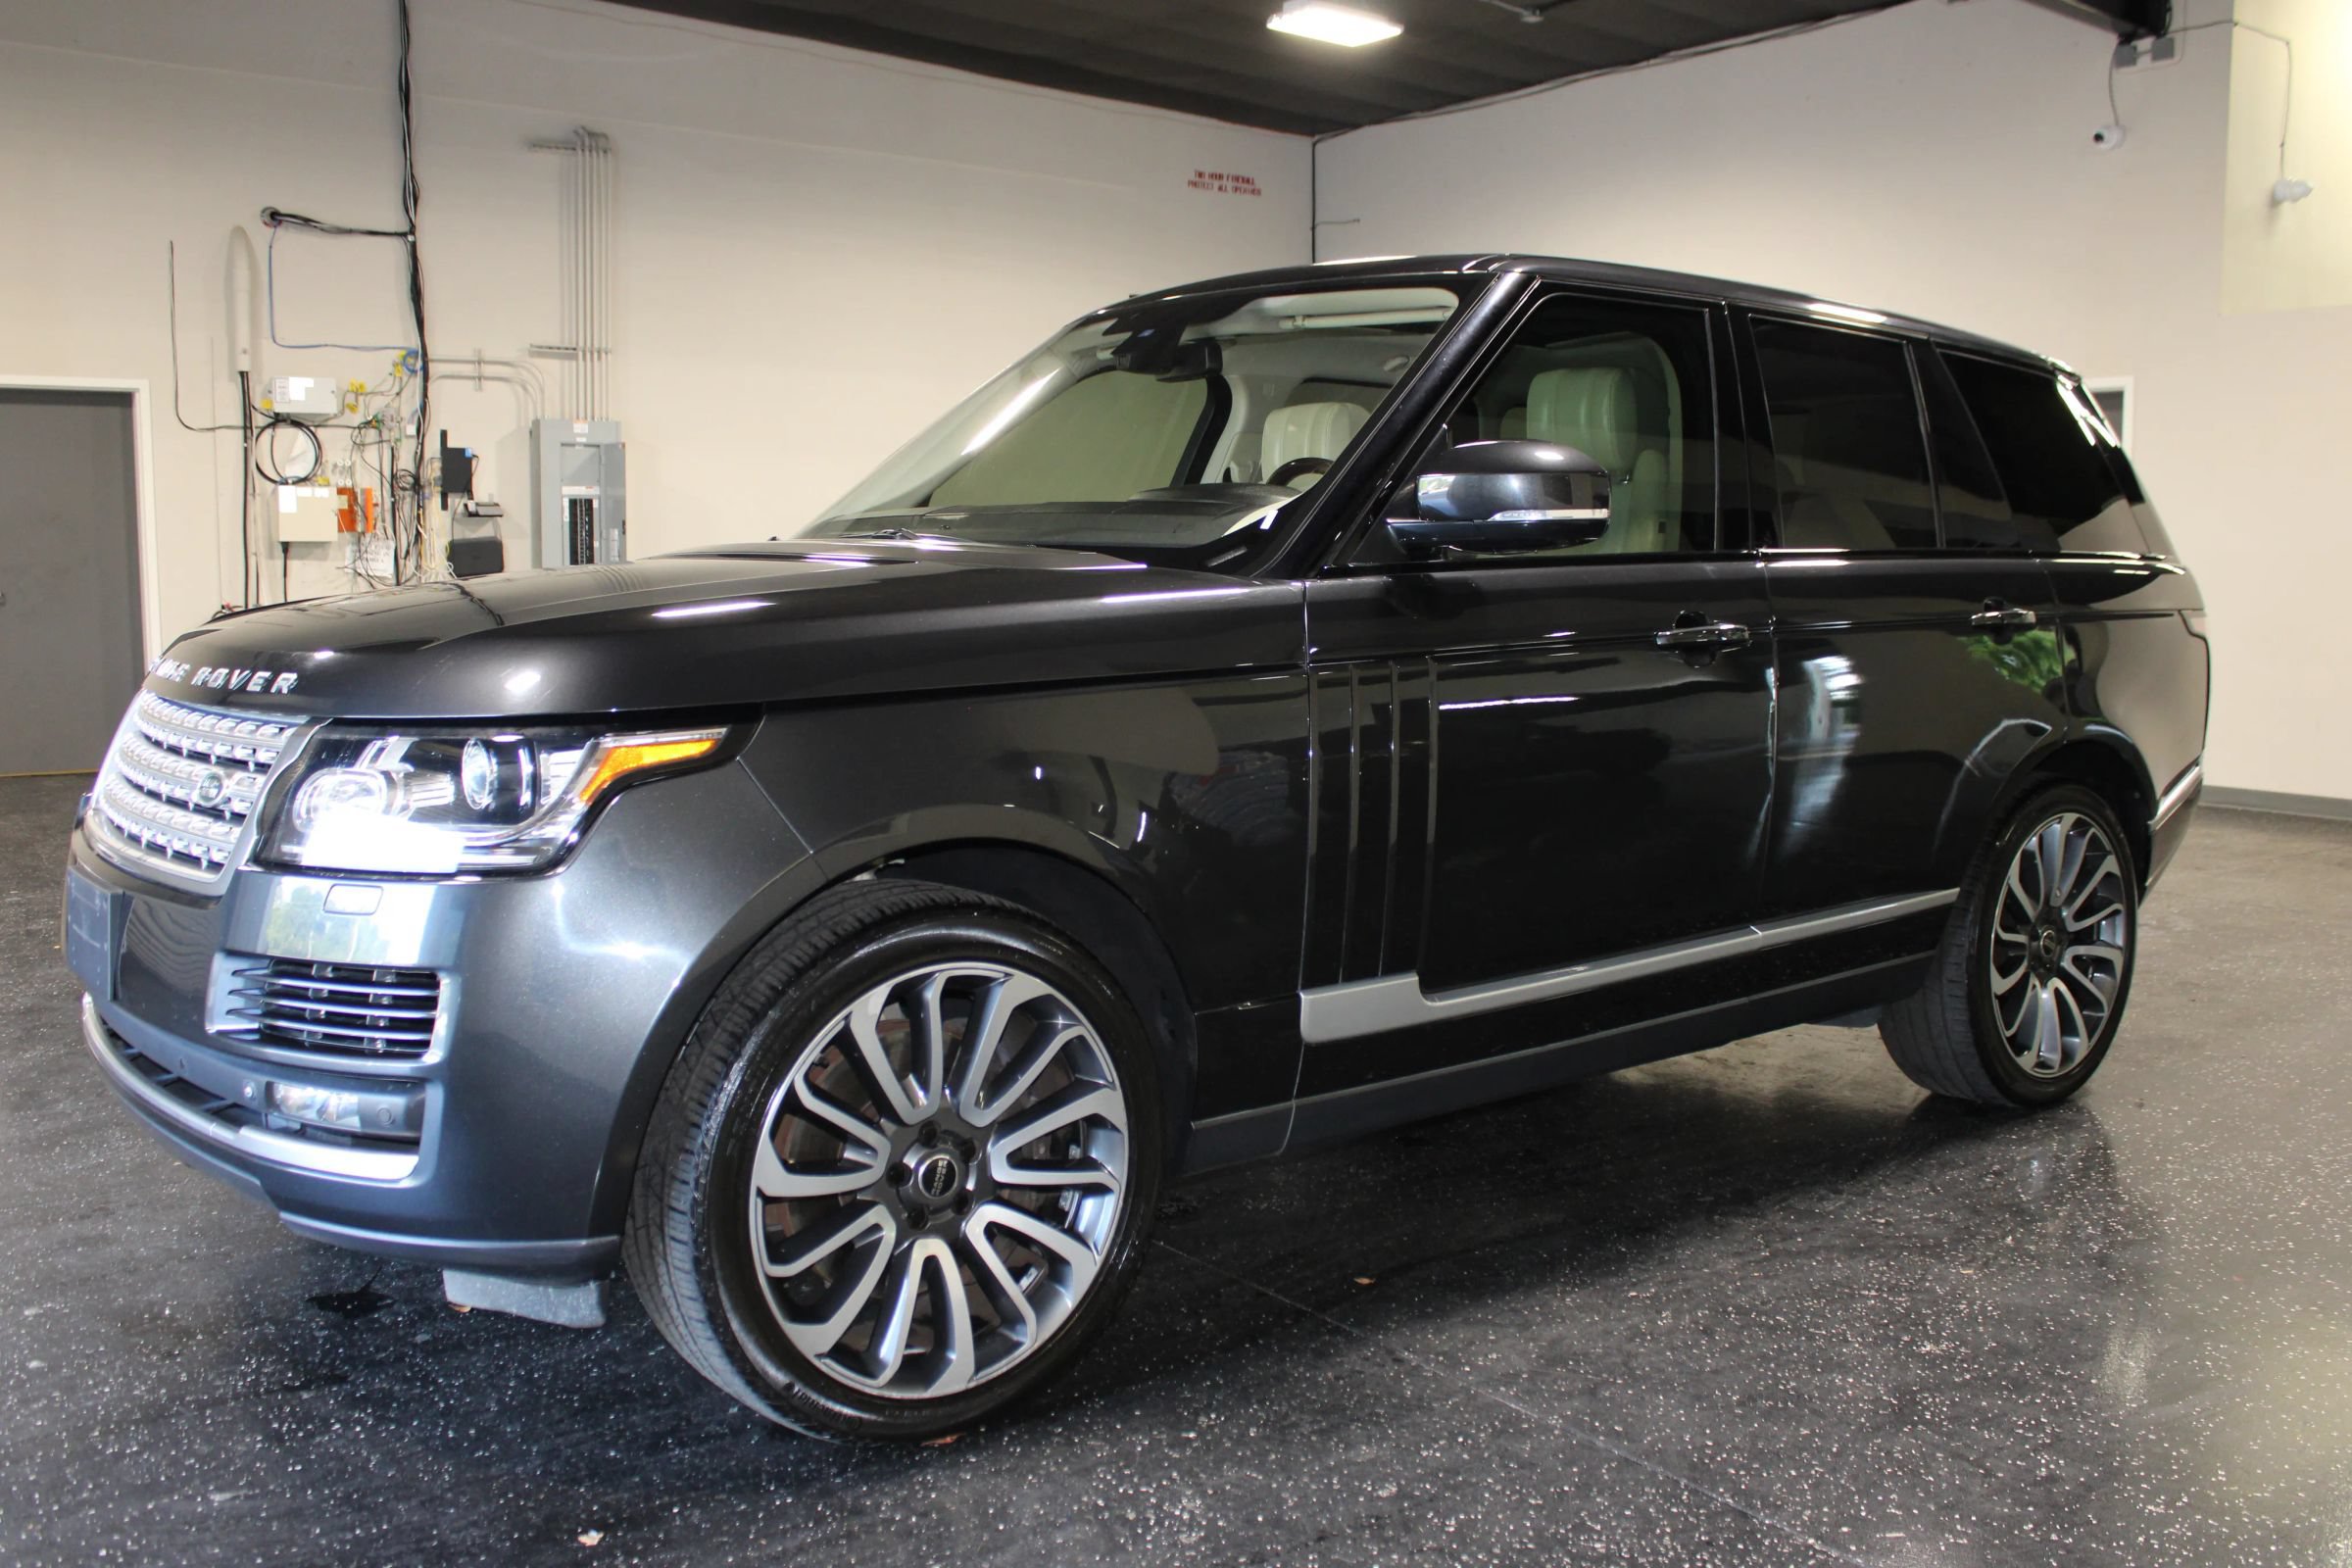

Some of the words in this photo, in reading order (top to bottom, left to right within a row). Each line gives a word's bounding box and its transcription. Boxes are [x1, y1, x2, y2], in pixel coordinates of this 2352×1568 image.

[191, 666, 298, 694] ROVER
[931, 1159, 943, 1195] RANGE
[936, 1159, 948, 1195] ROVER
